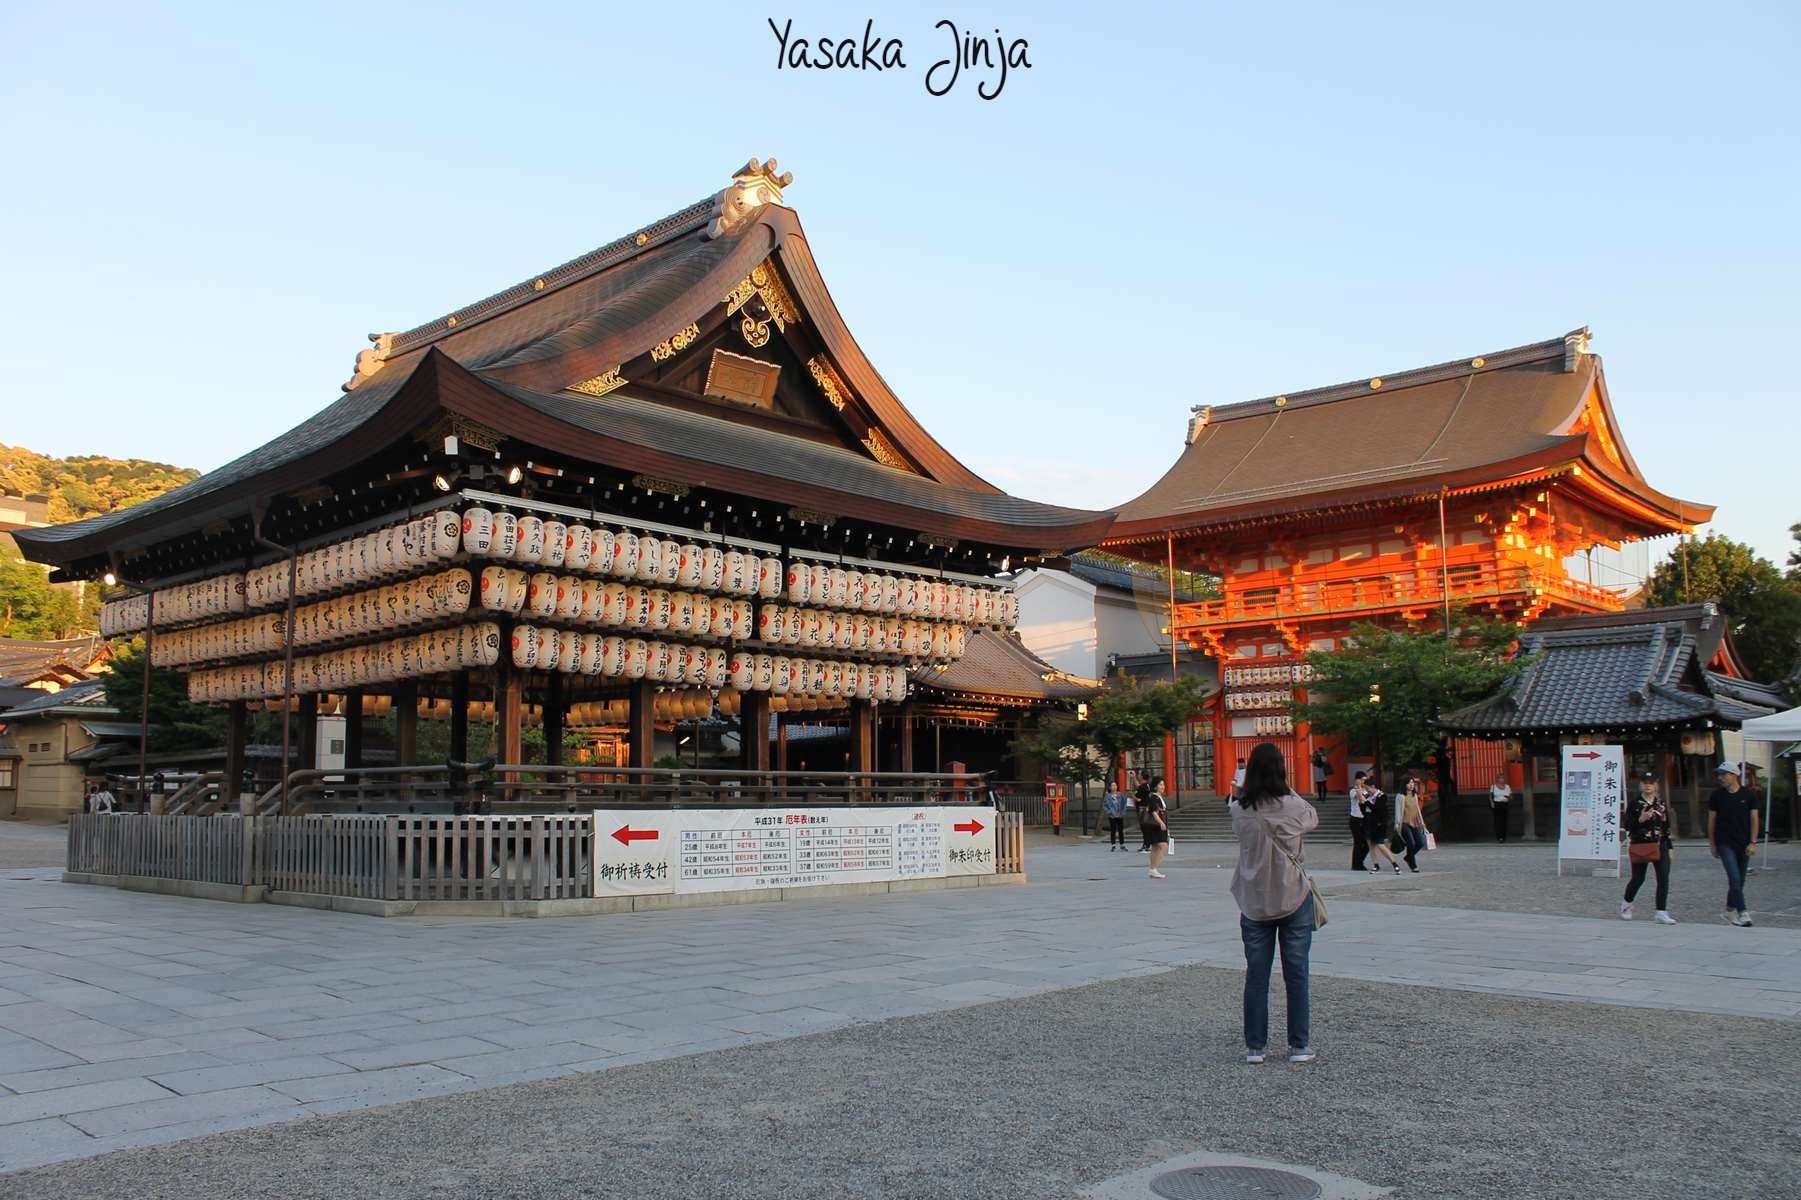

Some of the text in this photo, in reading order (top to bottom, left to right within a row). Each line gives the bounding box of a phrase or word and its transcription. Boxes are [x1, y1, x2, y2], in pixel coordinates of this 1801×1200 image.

[1602, 759, 1618, 843] 御朱印受付
[755, 816, 783, 825] 平成31年
[599, 861, 670, 881] 御祈祷受付
